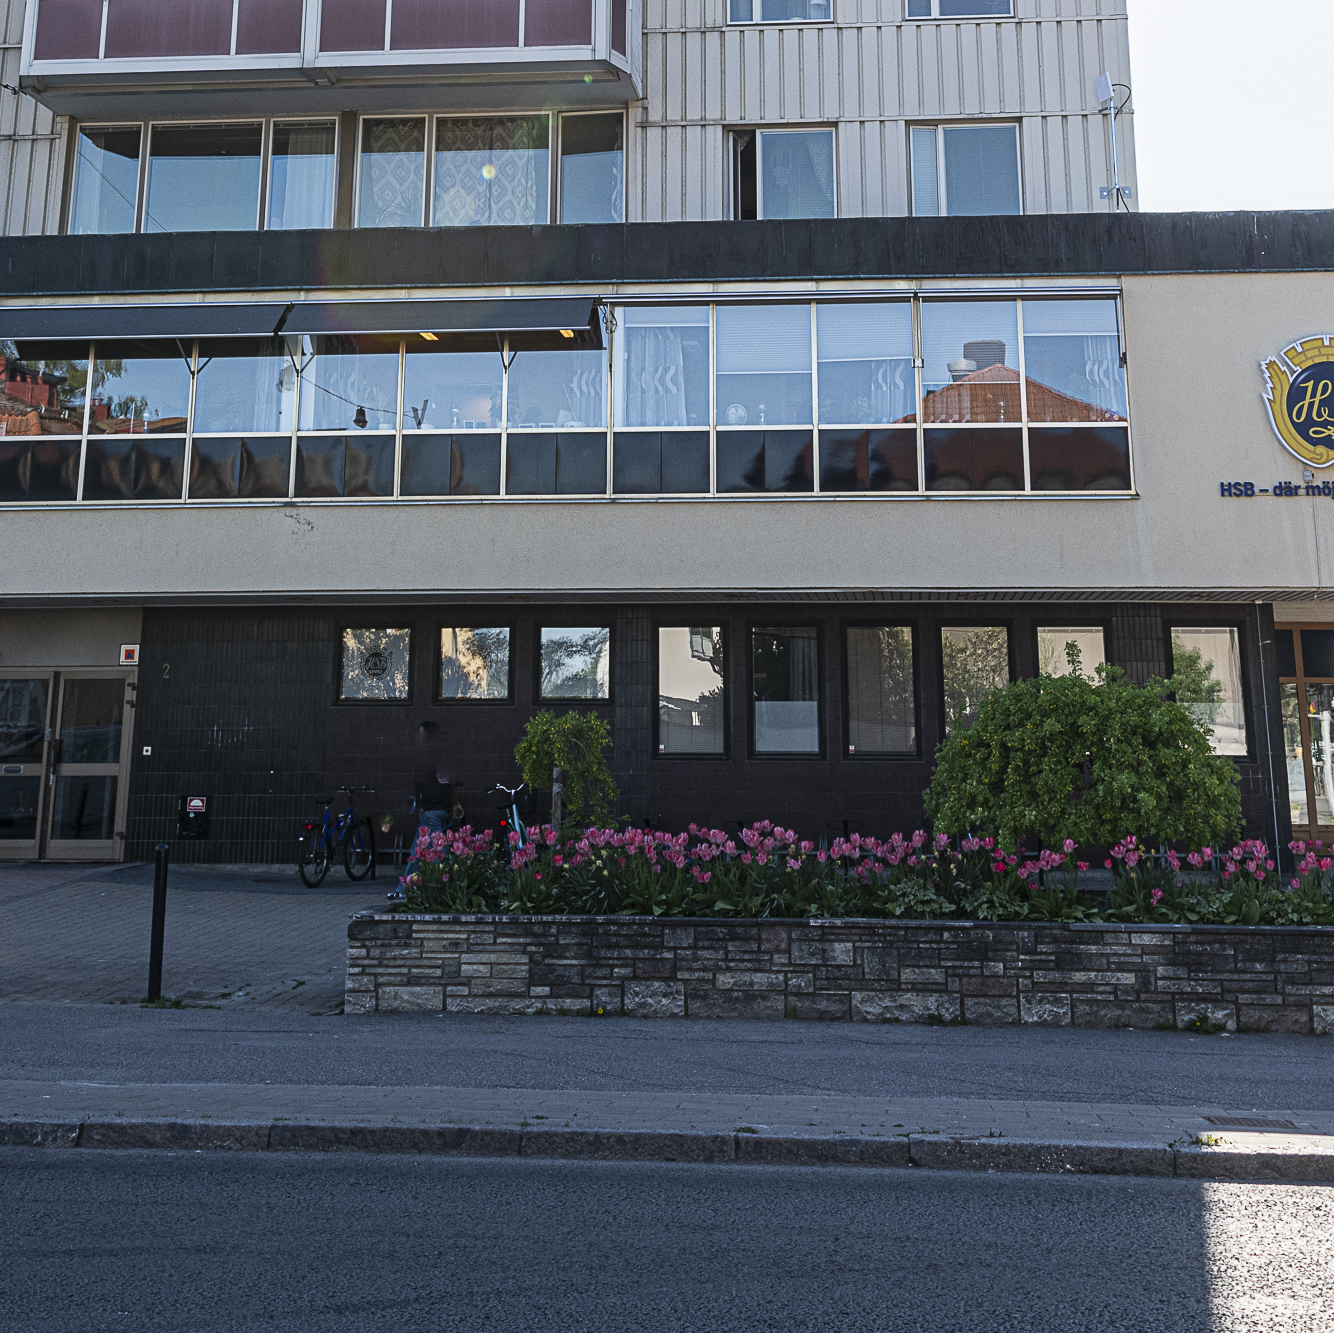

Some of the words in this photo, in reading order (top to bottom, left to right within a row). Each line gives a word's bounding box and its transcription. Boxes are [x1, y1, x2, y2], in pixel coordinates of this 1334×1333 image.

[1220, 481, 1256, 497] HSB
[1273, 481, 1301, 497] där
[162, 663, 171, 678] 2
